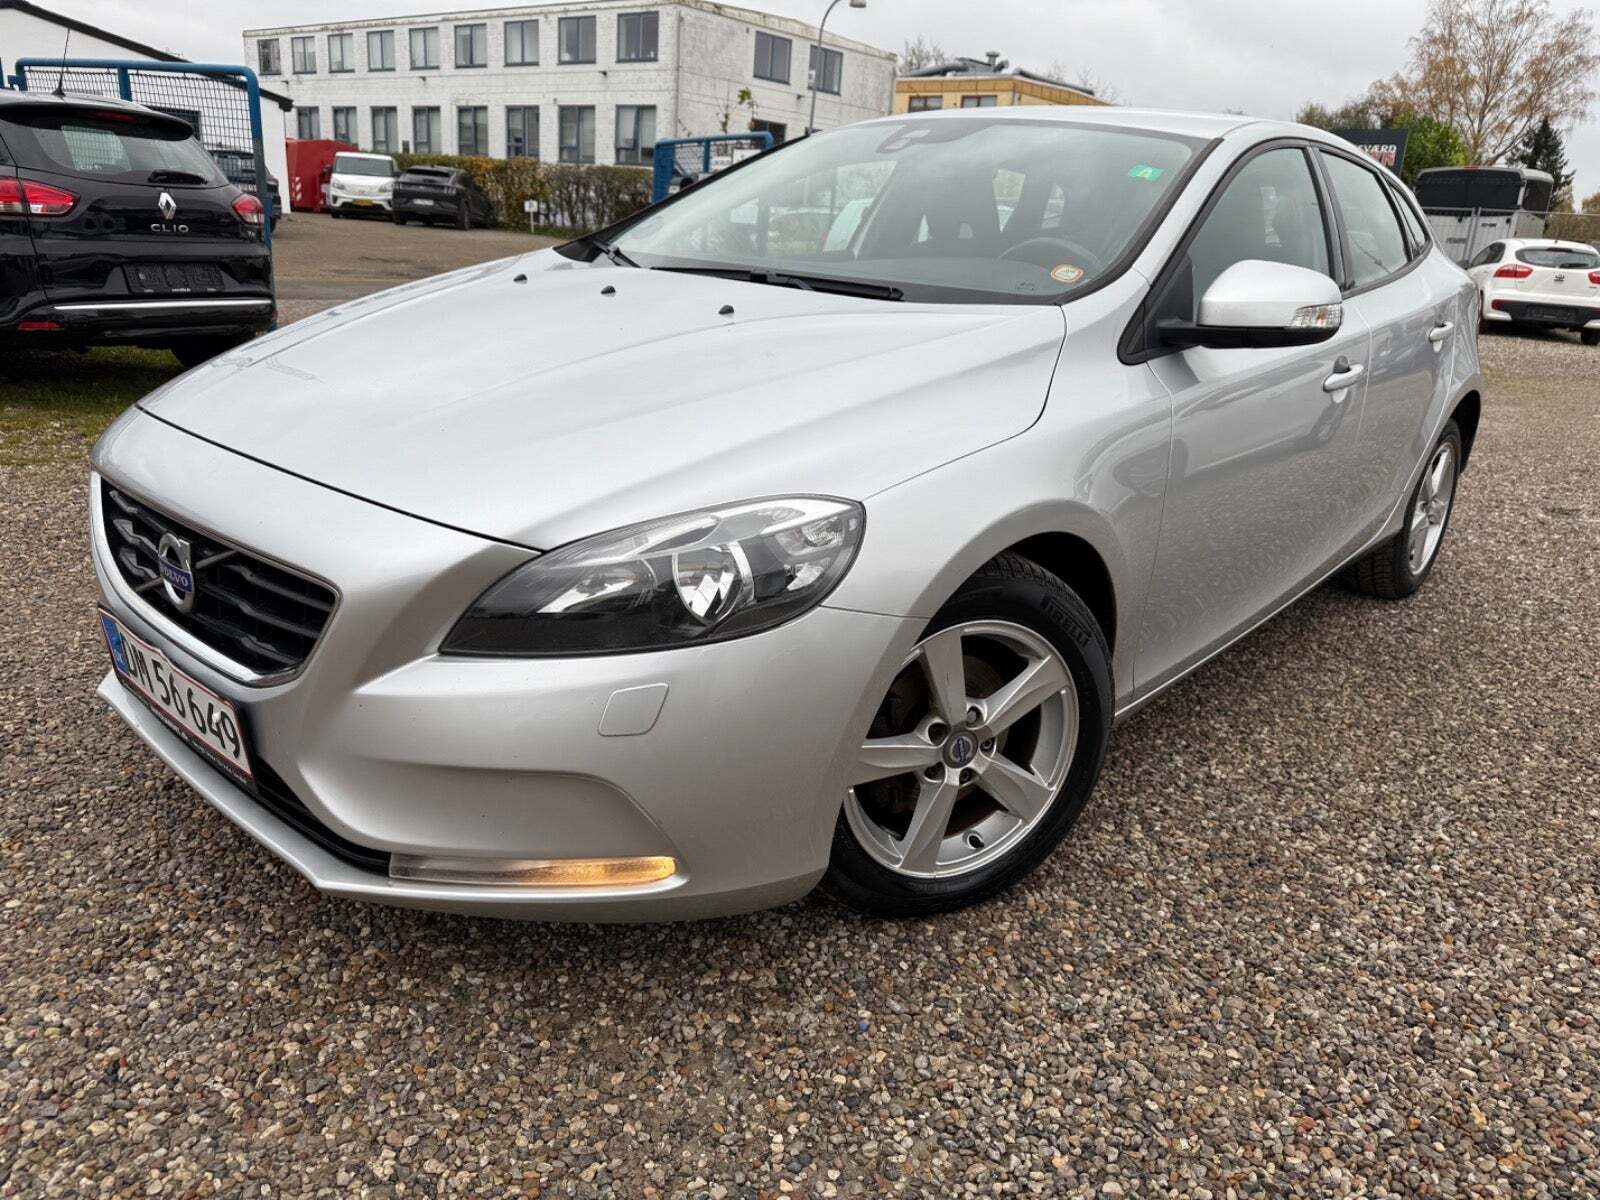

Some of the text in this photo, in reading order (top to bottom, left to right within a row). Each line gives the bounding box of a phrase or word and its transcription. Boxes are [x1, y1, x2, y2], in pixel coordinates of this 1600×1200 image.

[150, 223, 189, 233] CLIO
[120, 632, 154, 694] DM
[152, 658, 186, 718] 56
[187, 687, 240, 758] 649
